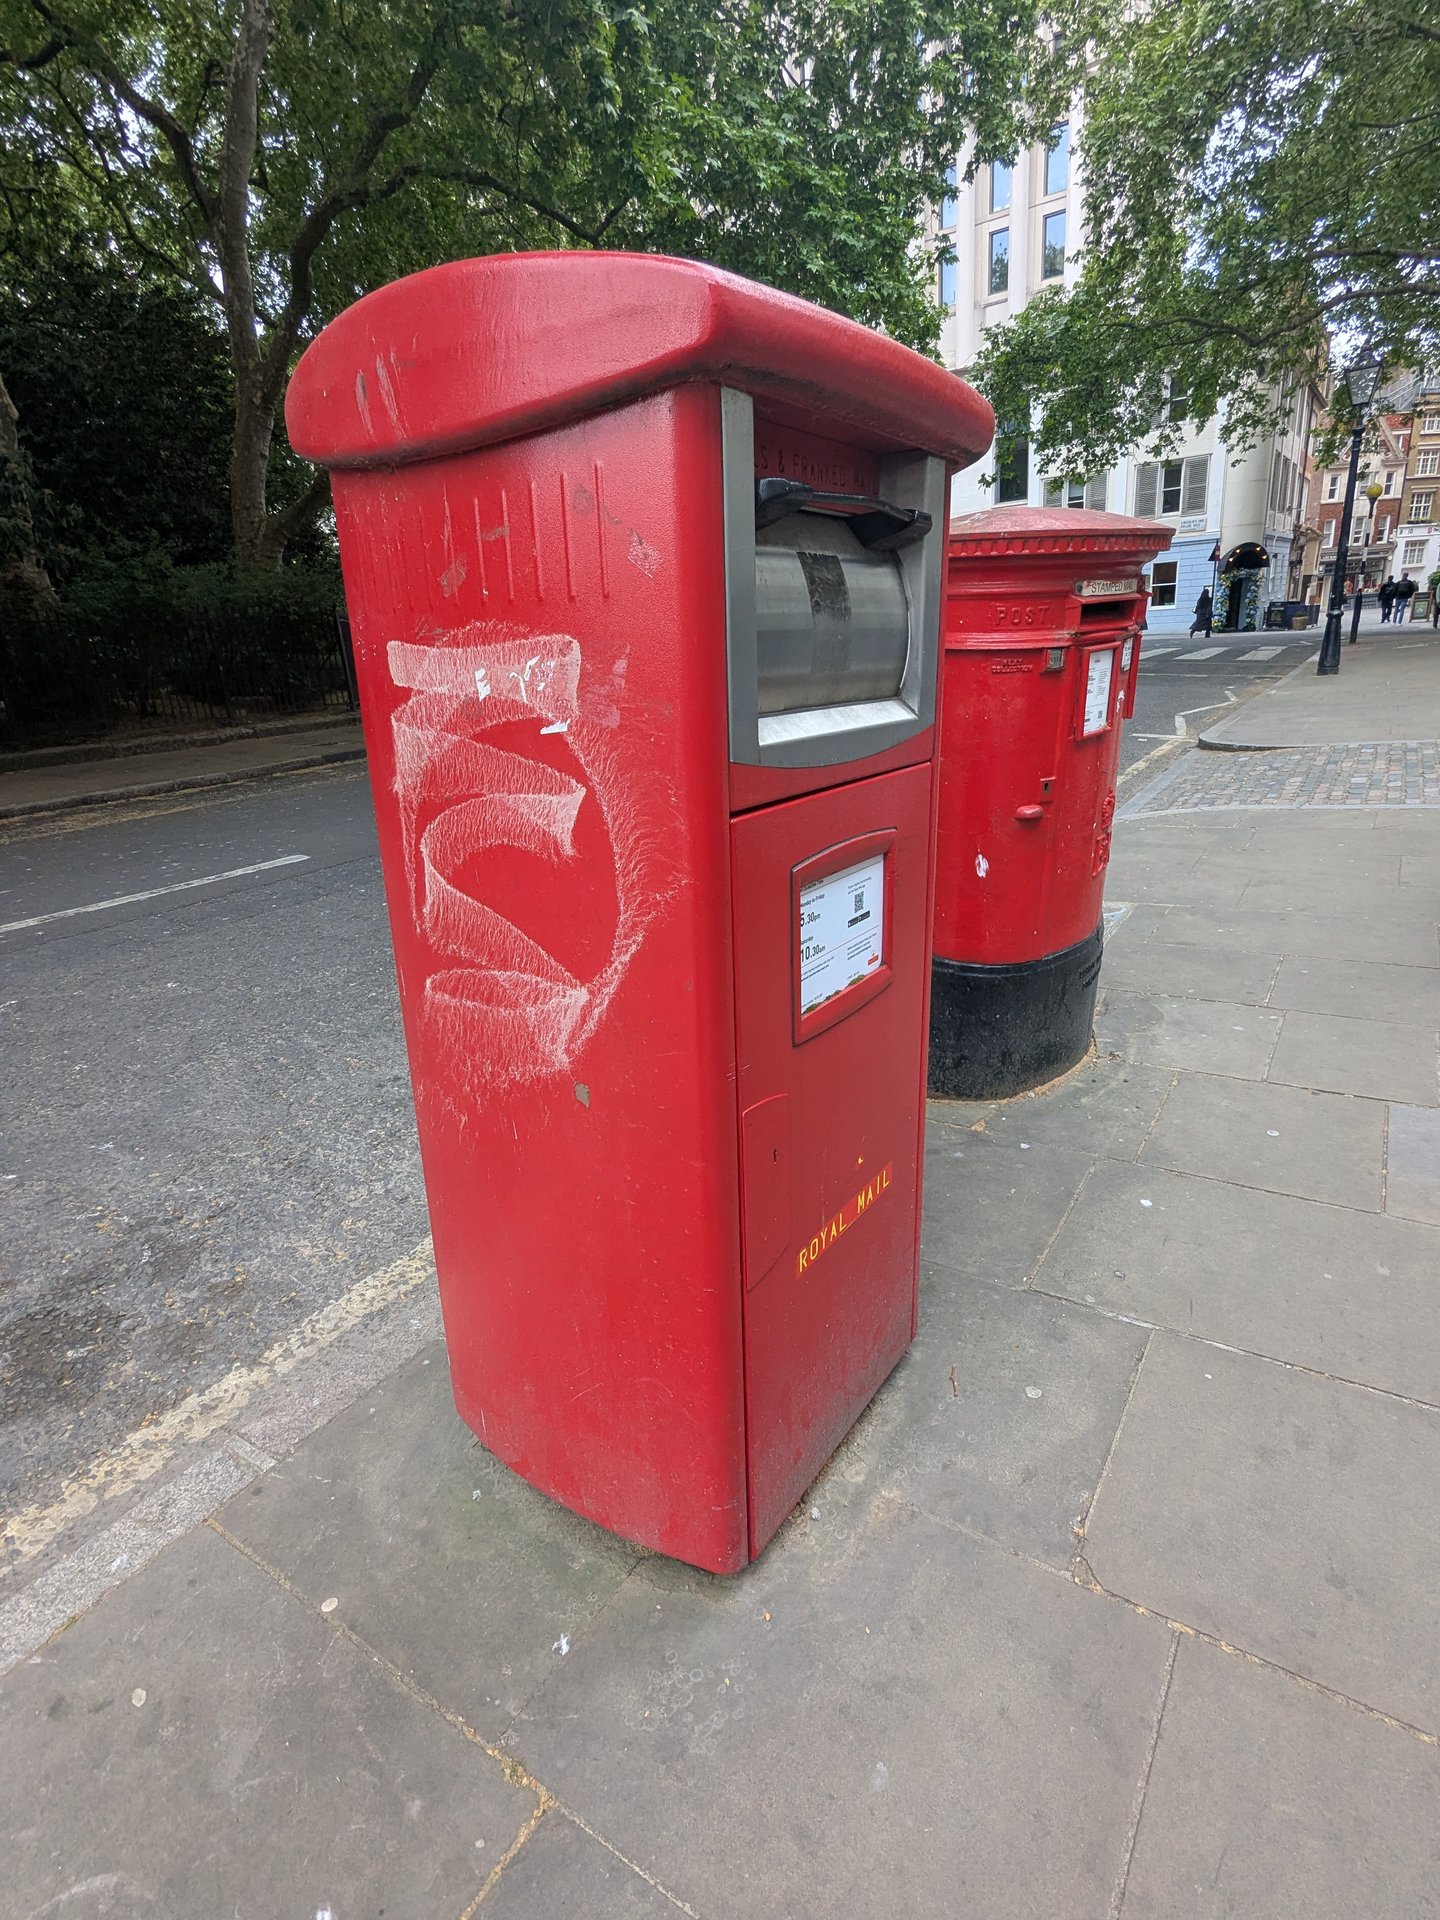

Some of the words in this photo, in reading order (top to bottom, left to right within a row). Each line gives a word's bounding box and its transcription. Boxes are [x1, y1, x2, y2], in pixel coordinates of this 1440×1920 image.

[777, 449, 786, 474] &
[793, 453, 846, 487] FRANKED
[1091, 581, 1123, 594] STAMPED
[996, 605, 1049, 626] POST
[799, 1212, 847, 1273] ROYAL
[857, 1169, 890, 1214] MAIL
